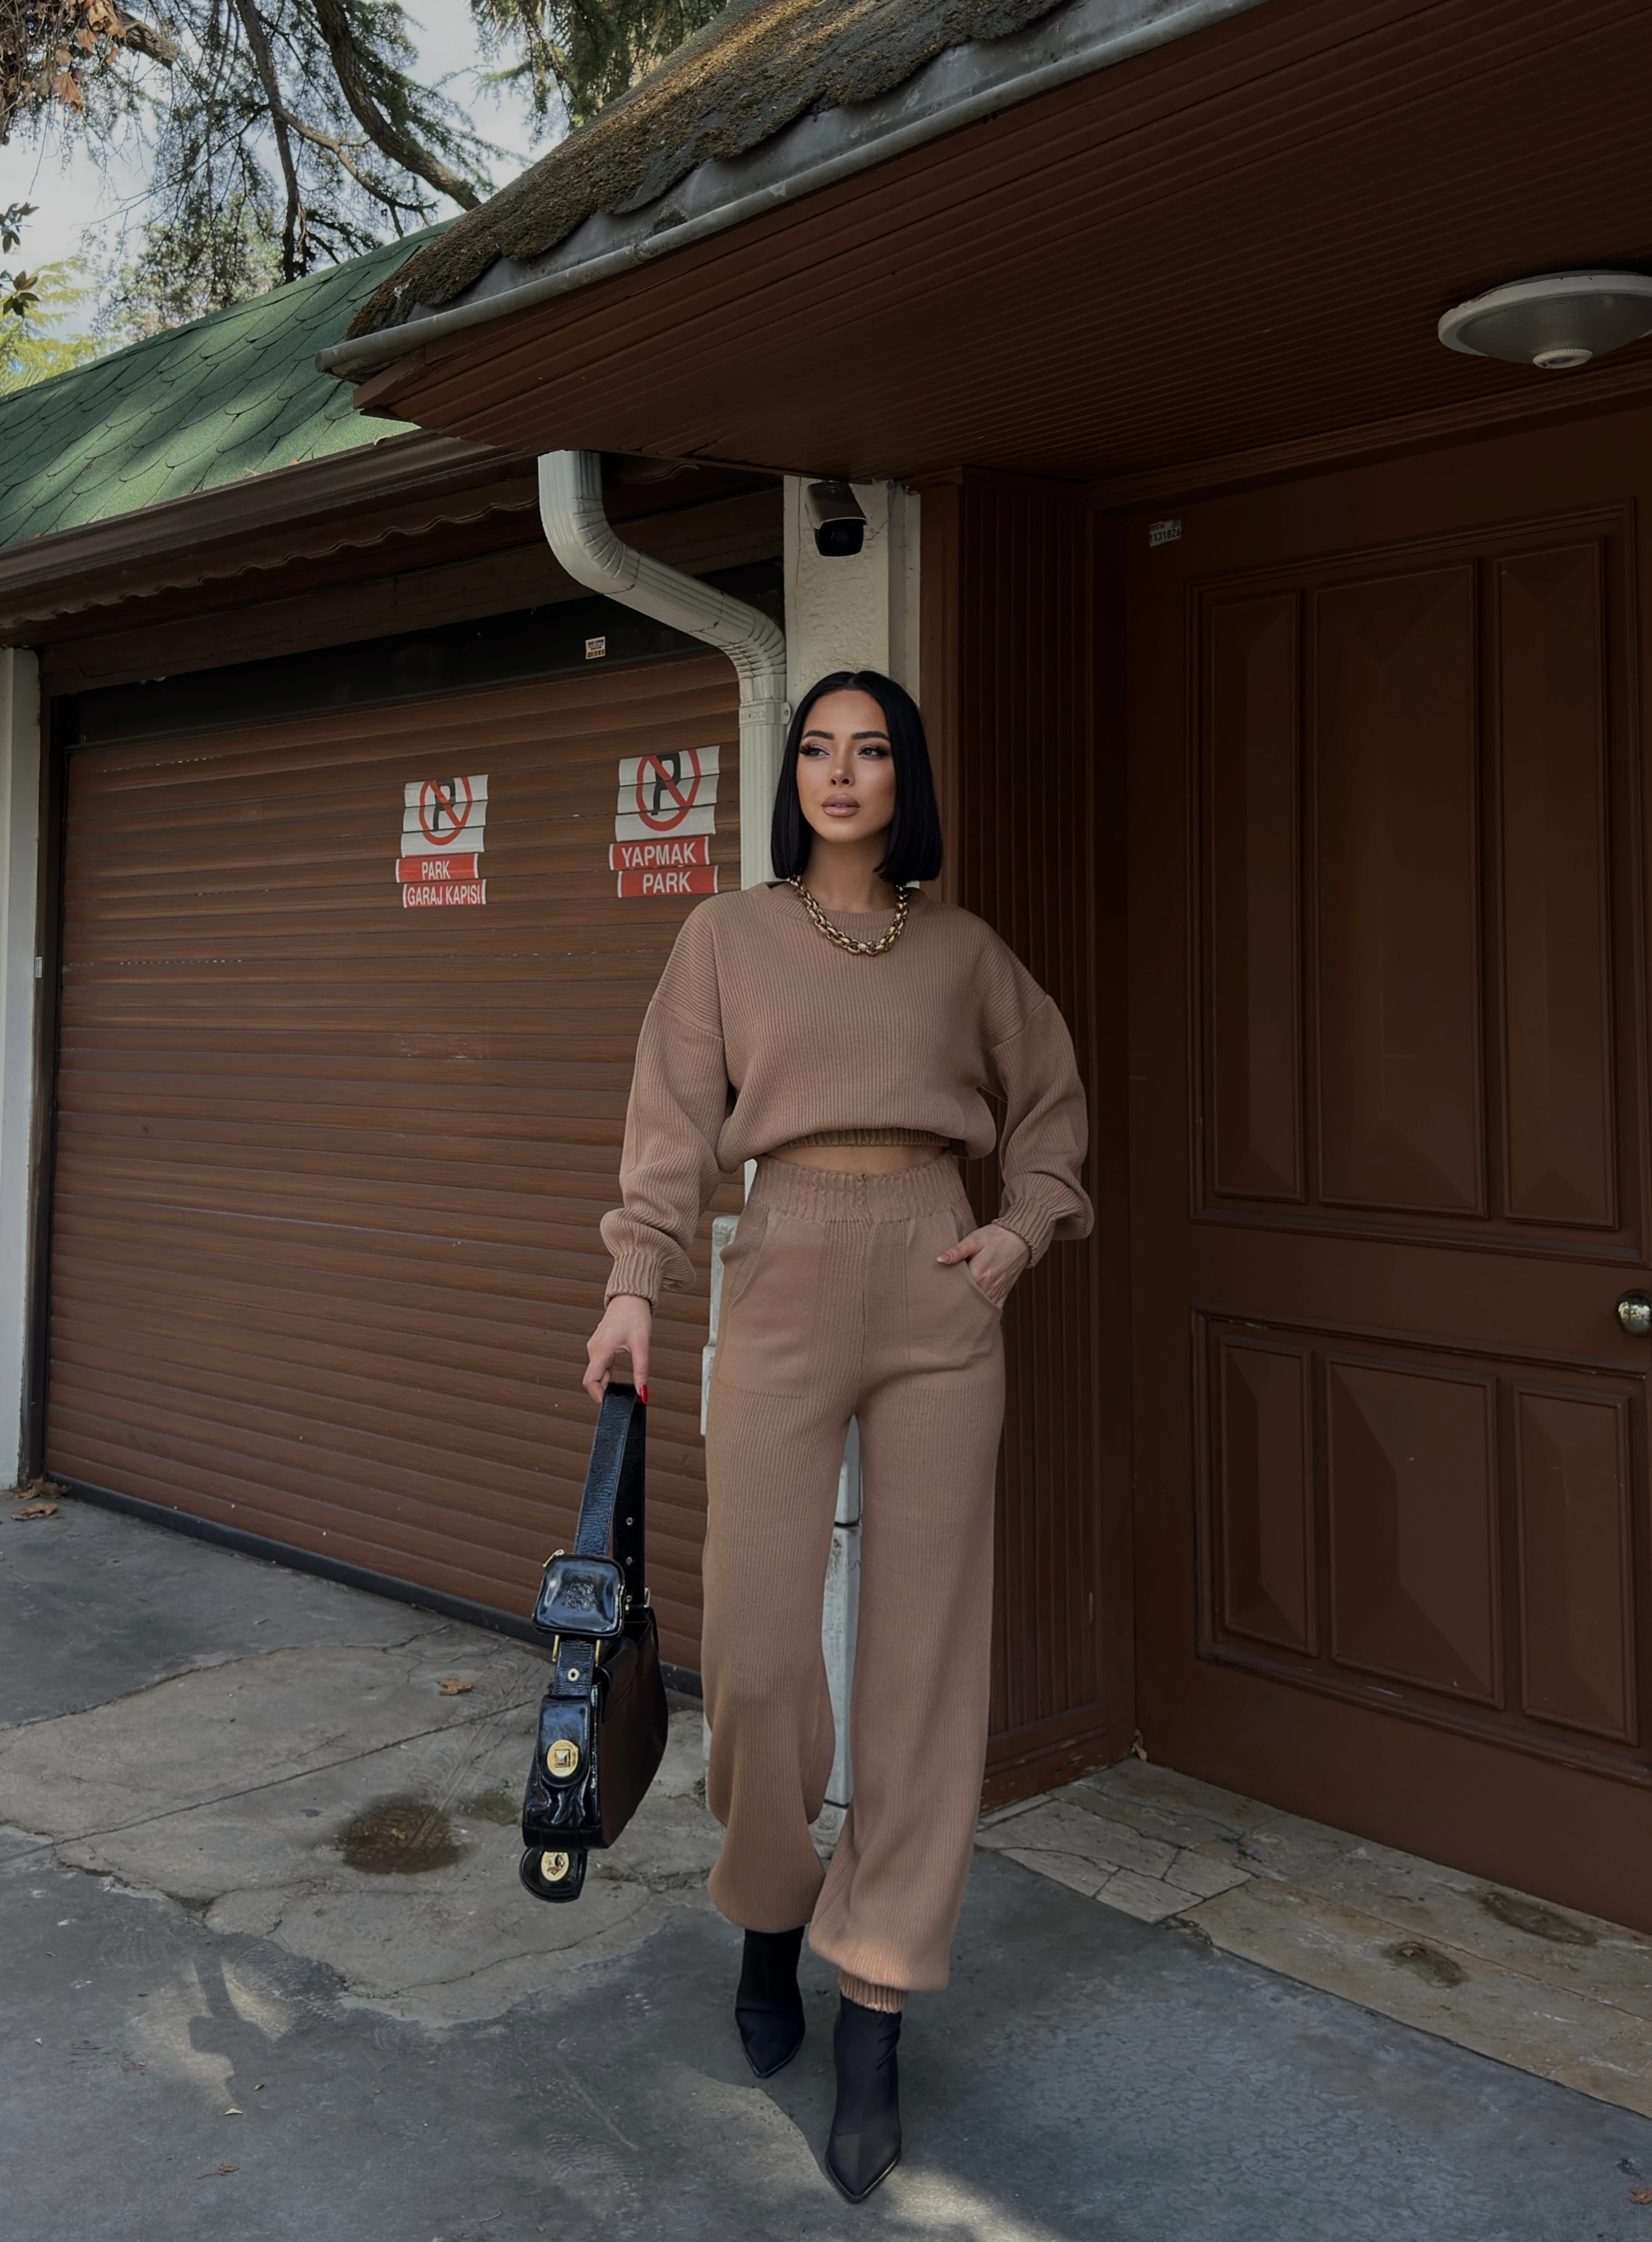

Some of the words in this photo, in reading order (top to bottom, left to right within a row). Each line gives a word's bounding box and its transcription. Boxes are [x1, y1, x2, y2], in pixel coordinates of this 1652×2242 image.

[621, 842, 697, 868] YAPMAK
[422, 861, 451, 880] PARK
[643, 871, 692, 894] PARK
[408, 886, 443, 906] GARAJ
[446, 885, 480, 904] KAPISI
